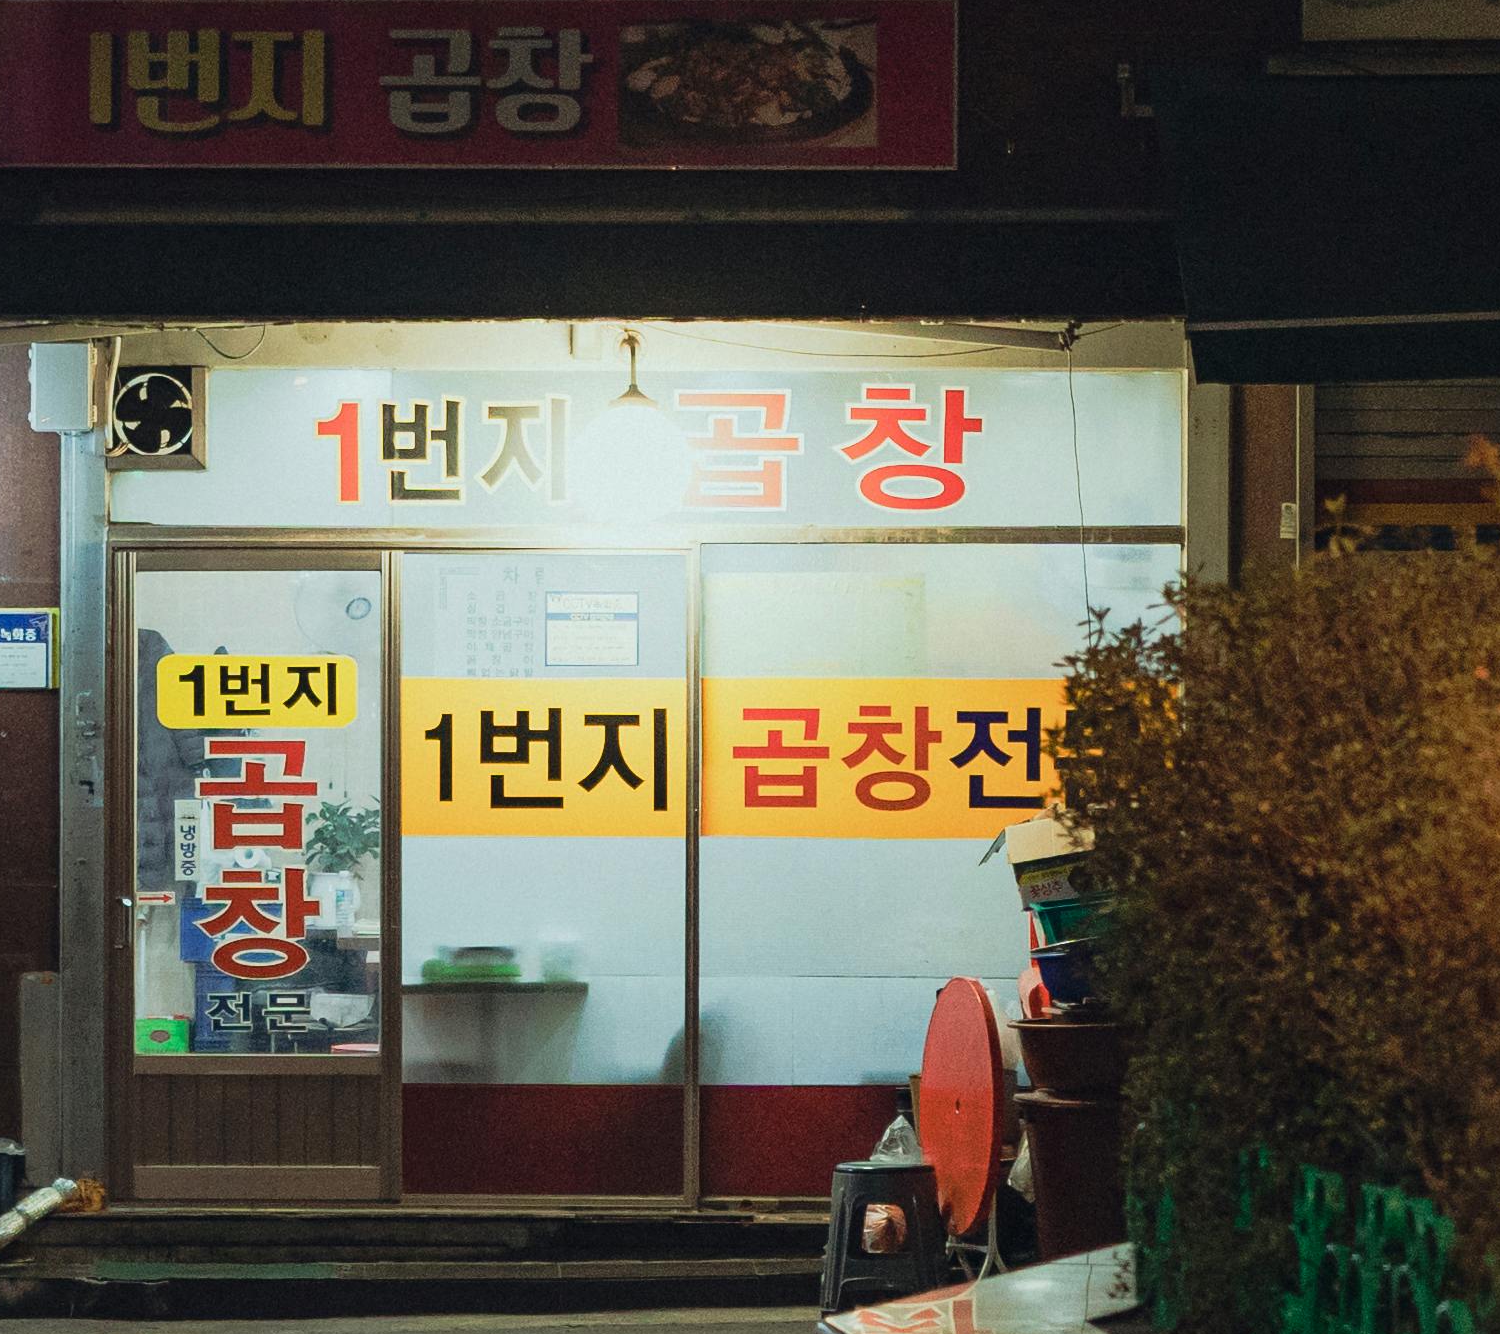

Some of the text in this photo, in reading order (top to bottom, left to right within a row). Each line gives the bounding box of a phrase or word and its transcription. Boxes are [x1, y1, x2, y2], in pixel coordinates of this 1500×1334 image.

[379, 26, 594, 135] 곱창
[316, 386, 986, 512] 1번지 곱창
[178, 663, 339, 717] 1번지
[424, 705, 1085, 812] 1번지 곱창전
[196, 738, 321, 979] 곱창
[206, 991, 311, 1033] 전문
